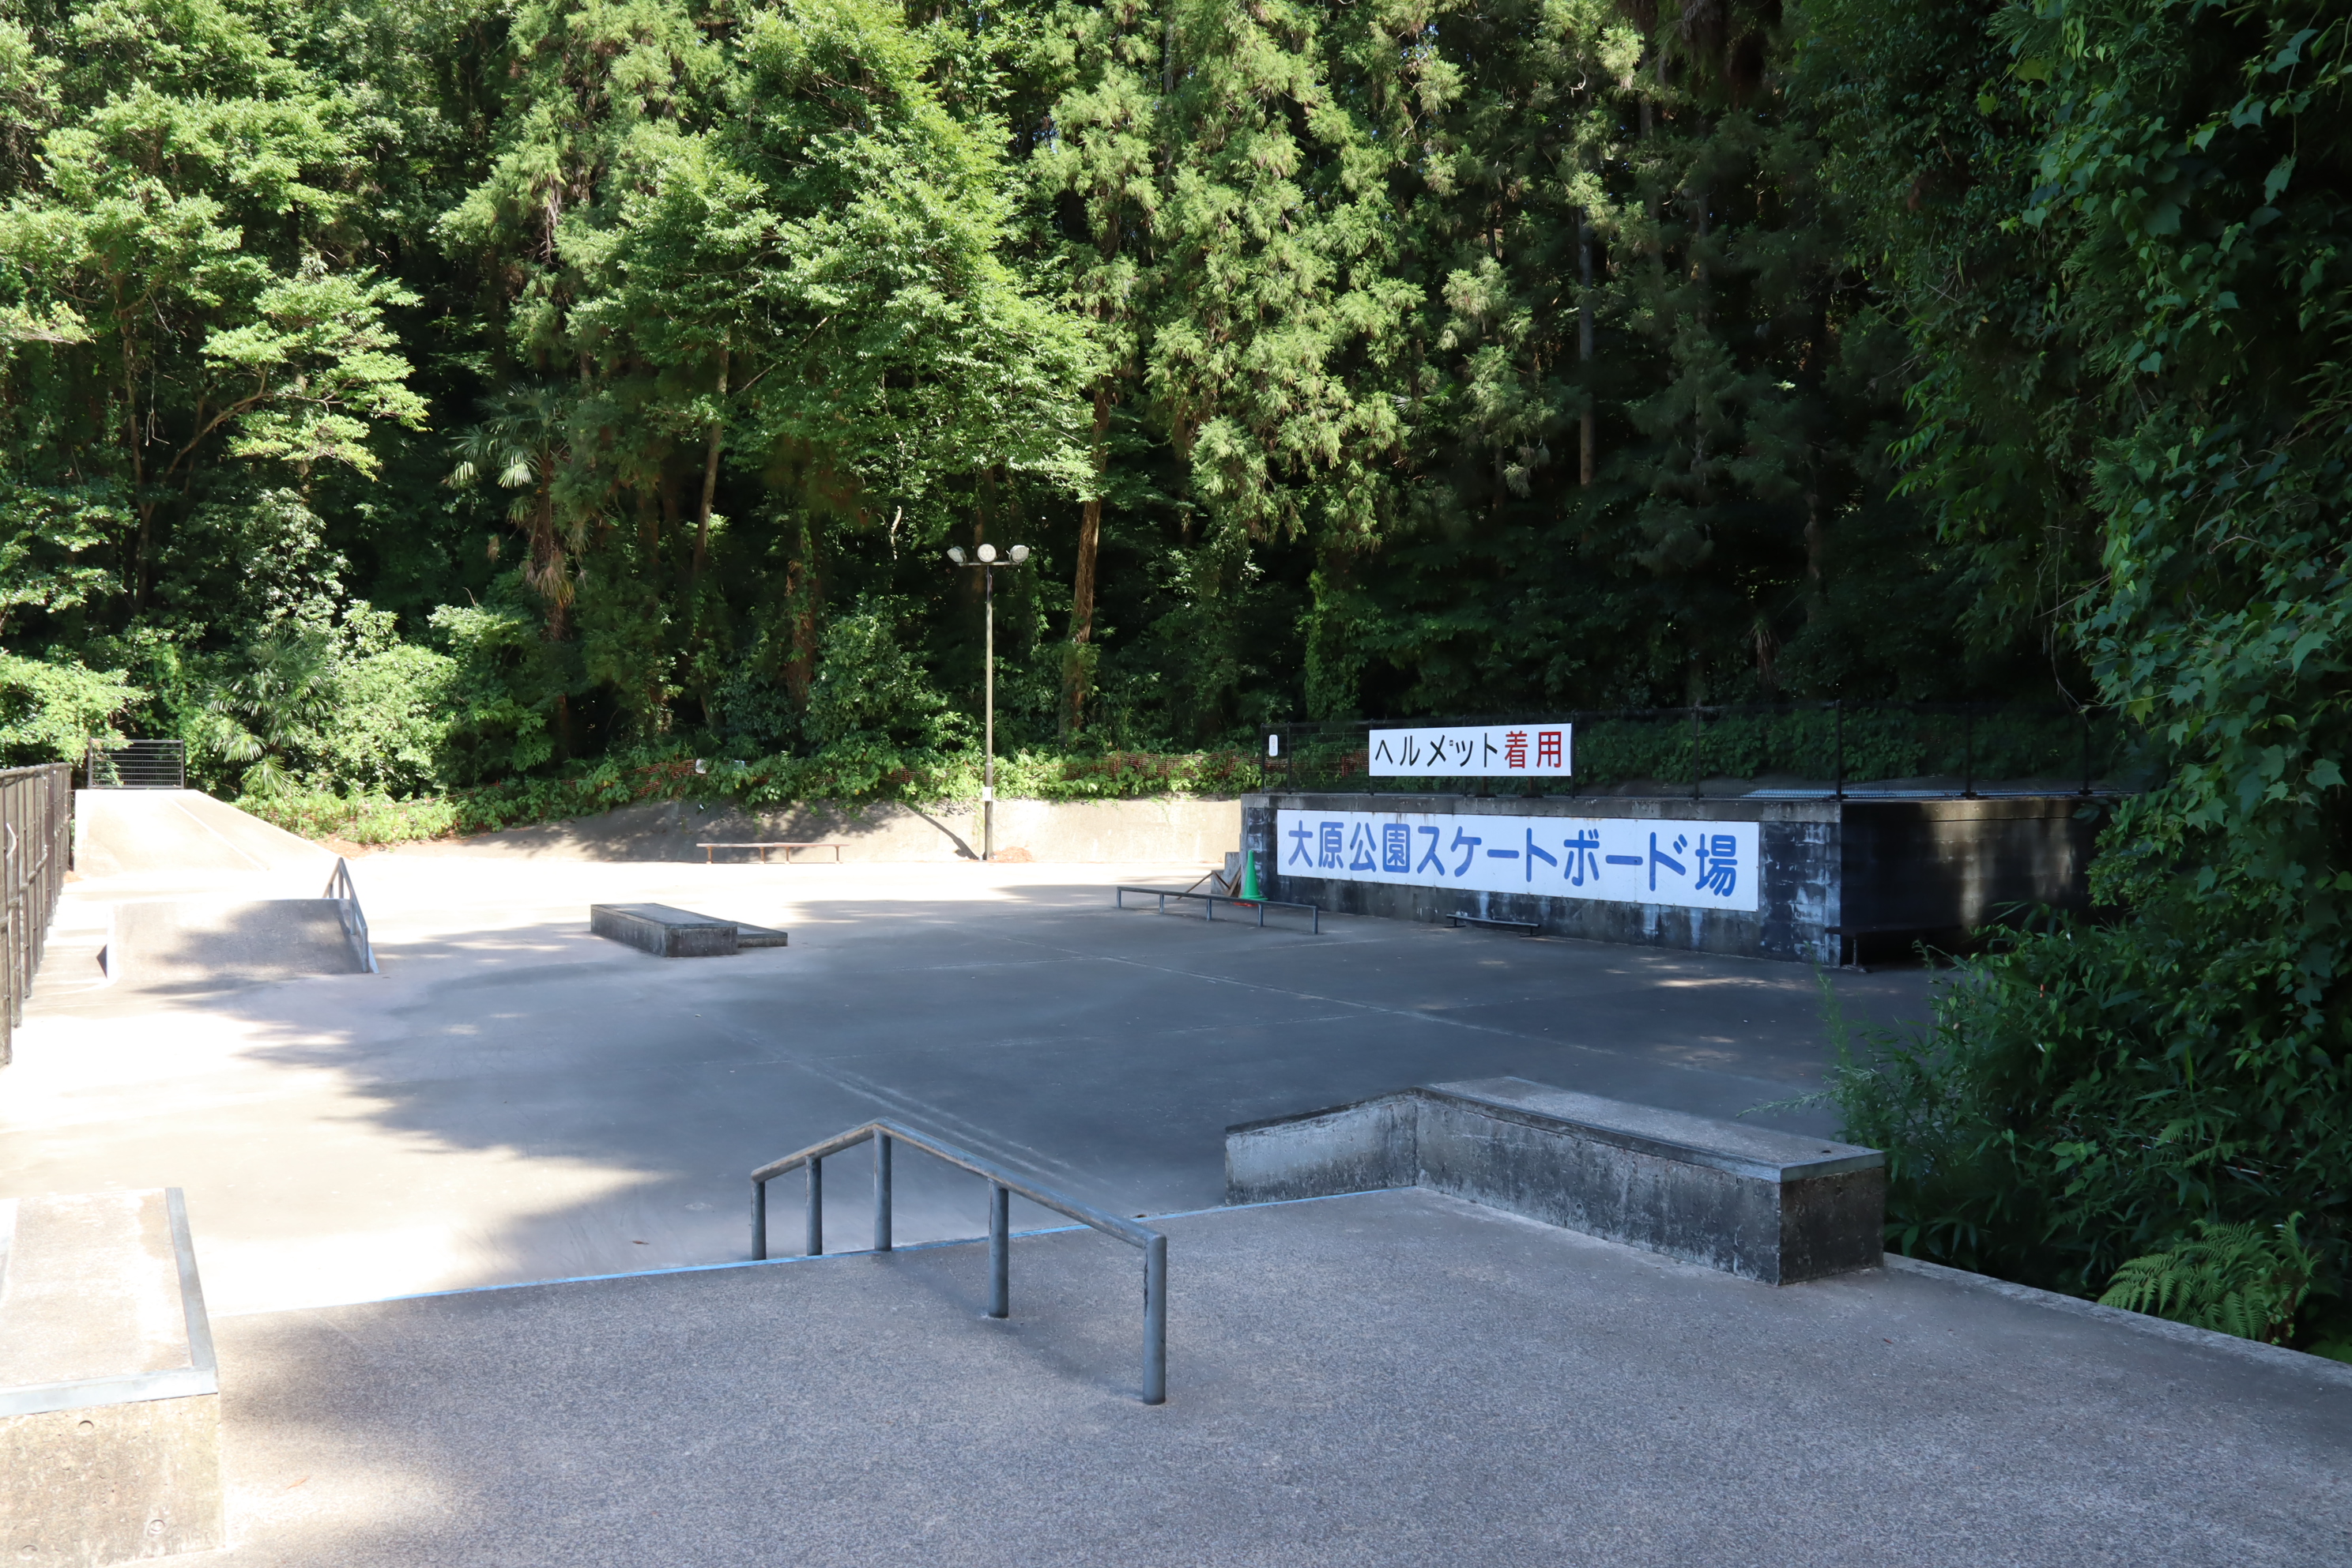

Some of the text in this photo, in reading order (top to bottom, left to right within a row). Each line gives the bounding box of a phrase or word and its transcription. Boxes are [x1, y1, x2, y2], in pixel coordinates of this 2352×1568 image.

[1375, 730, 1562, 769] ヘルメット着用
[1288, 820, 1737, 897] 大原公園スケートボード場
